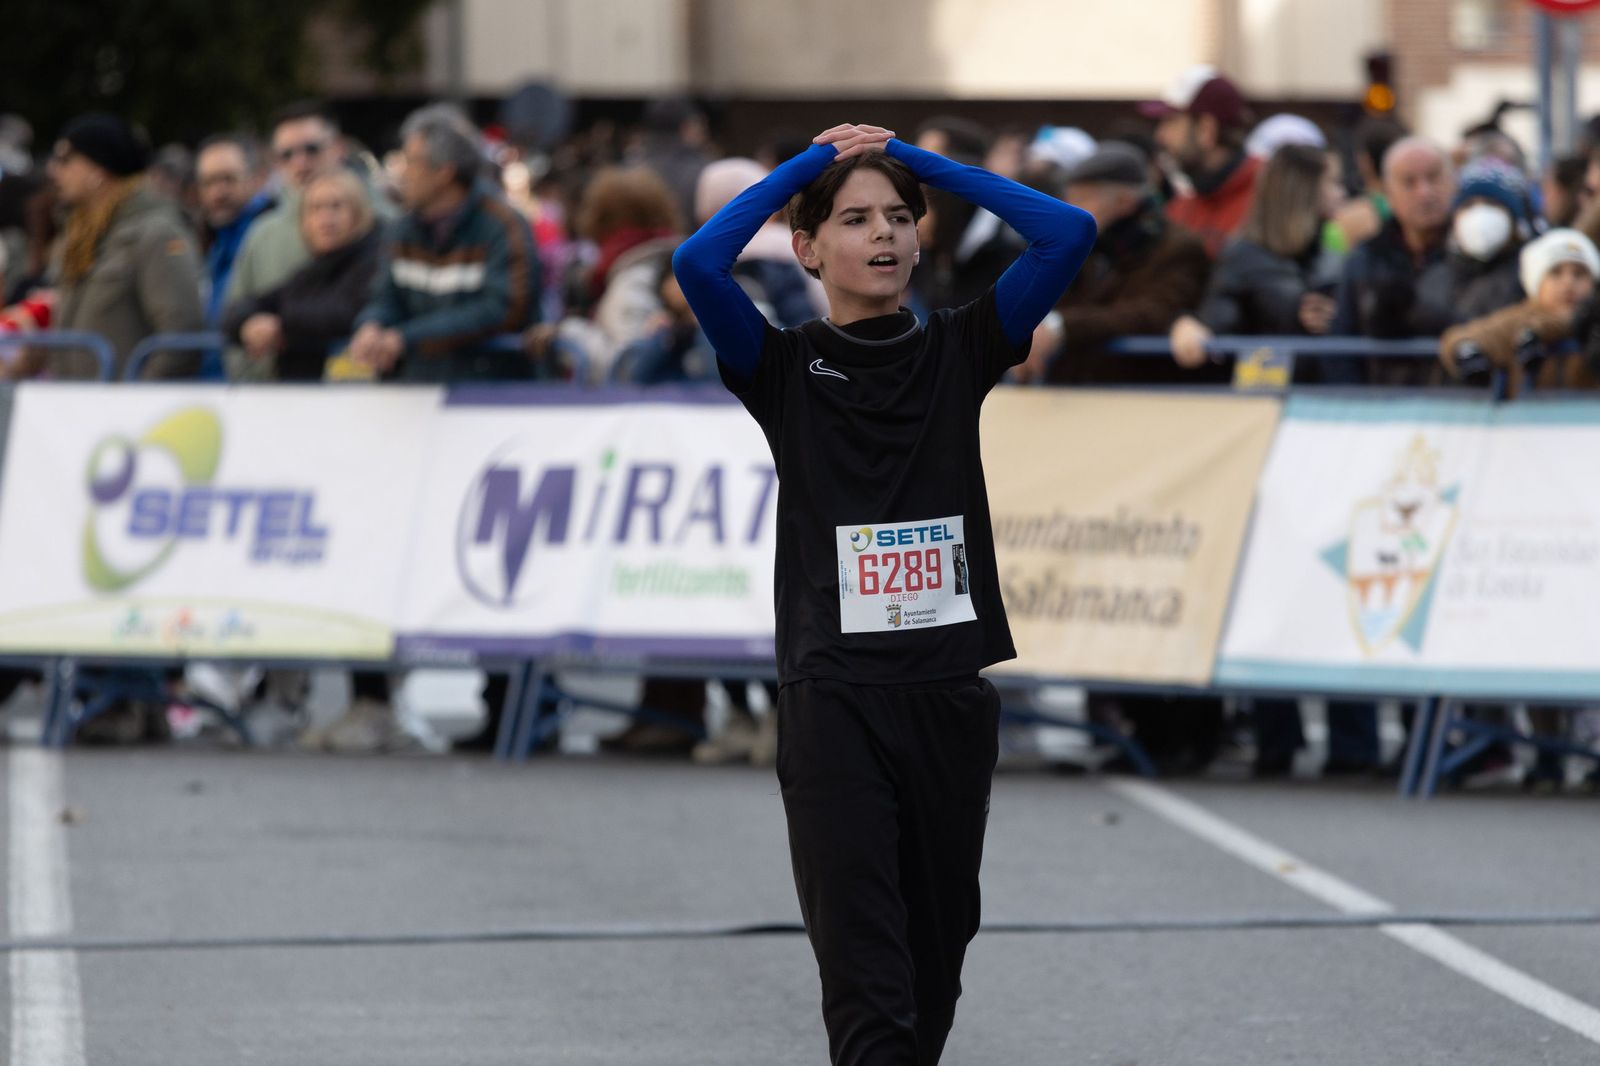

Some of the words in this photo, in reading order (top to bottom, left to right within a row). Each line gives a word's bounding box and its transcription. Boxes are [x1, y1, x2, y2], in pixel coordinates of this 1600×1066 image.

[128, 487, 330, 539] SETEL
[876, 524, 954, 547] SETEL
[858, 548, 942, 596] 6289
[890, 592, 919, 603] DIEGO
[1001, 565, 1182, 627] Salamanca
[903, 608, 937, 618] Ayuntamiento
[911, 617, 937, 625] Salamanca
